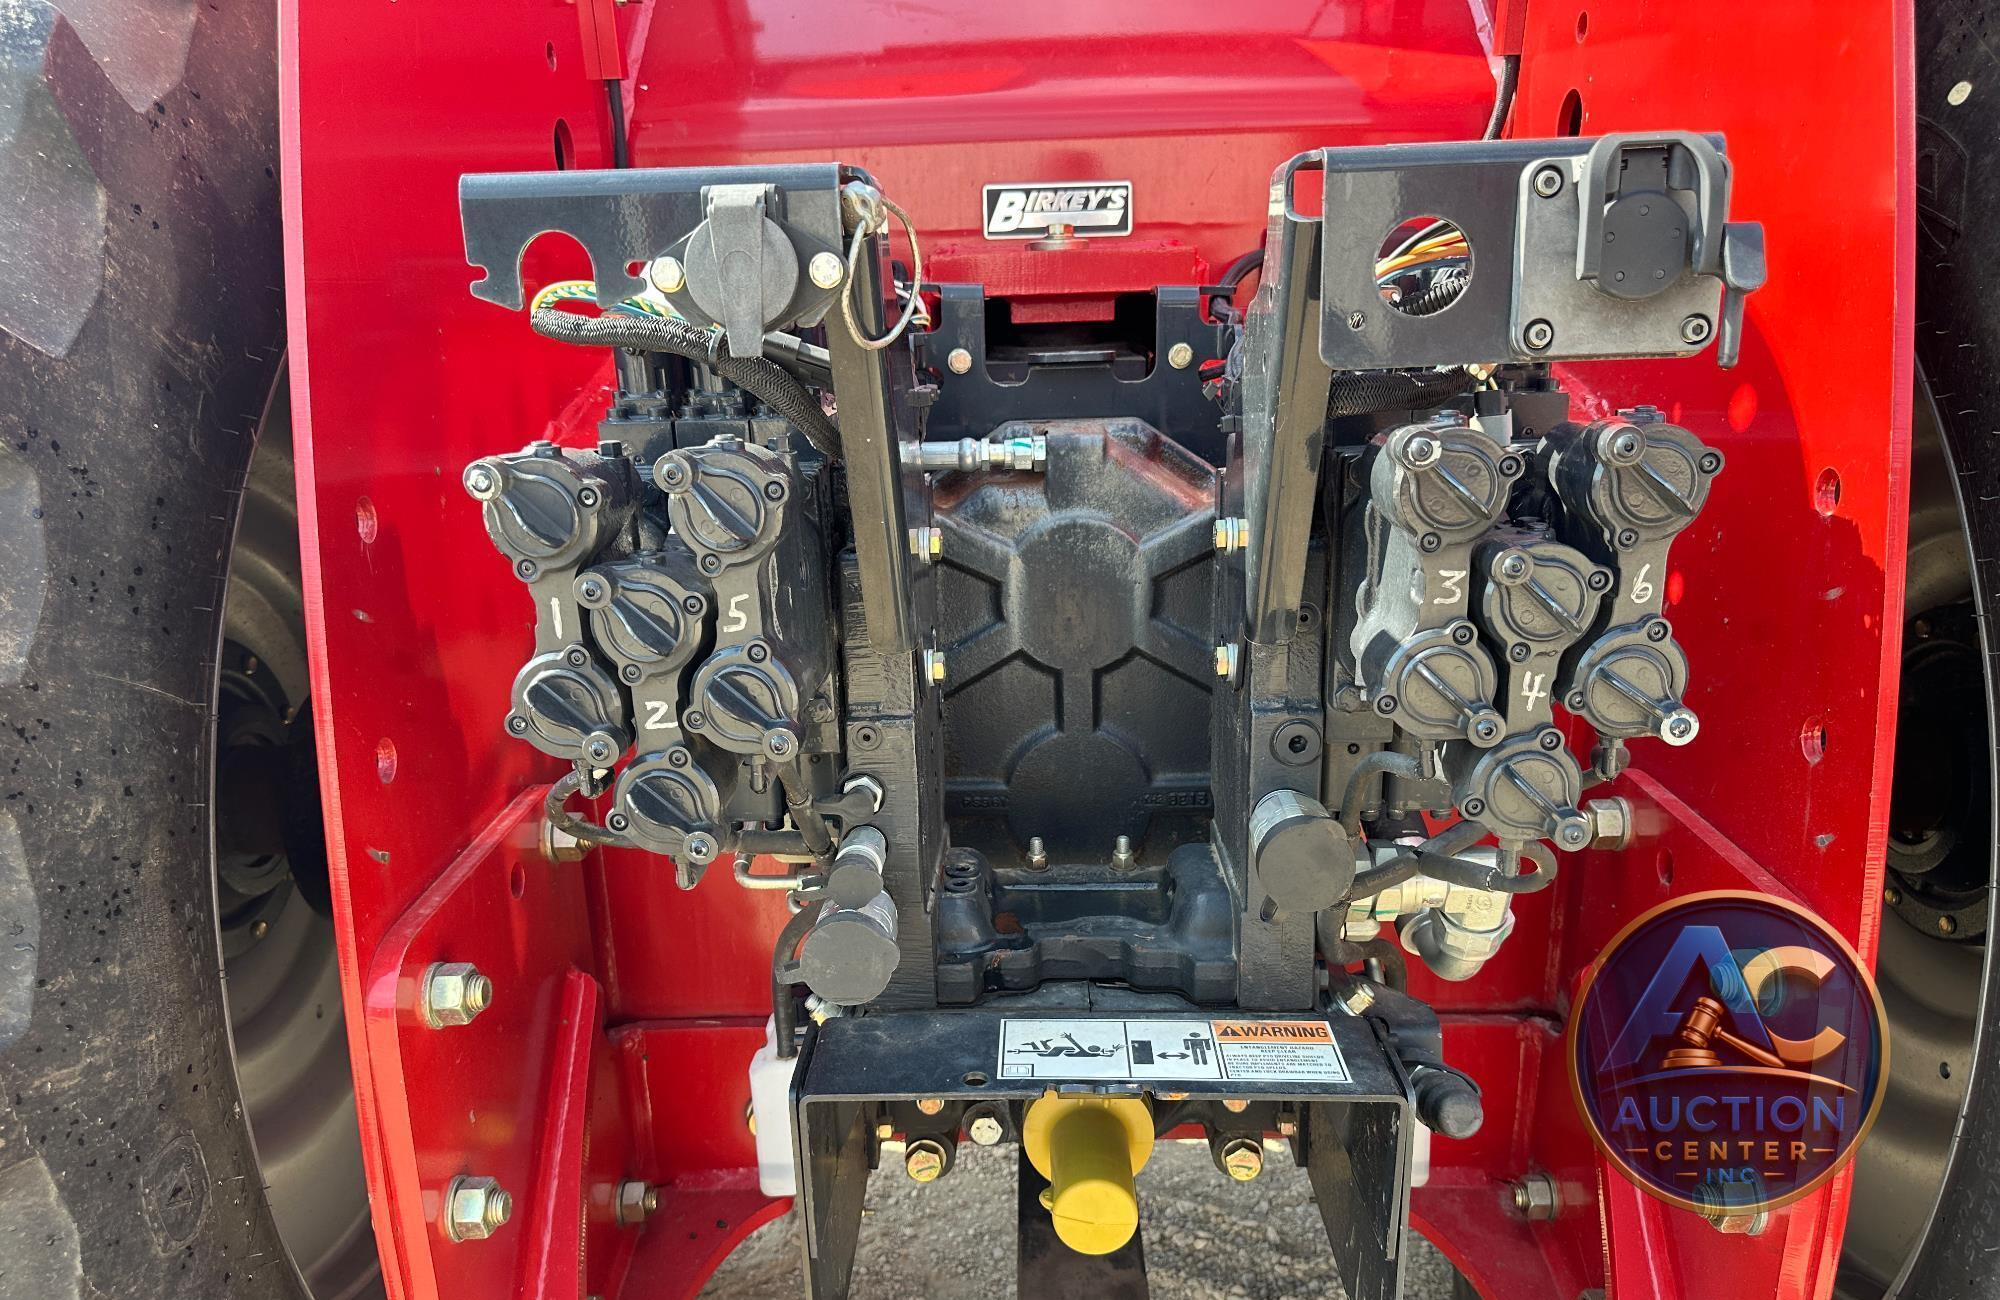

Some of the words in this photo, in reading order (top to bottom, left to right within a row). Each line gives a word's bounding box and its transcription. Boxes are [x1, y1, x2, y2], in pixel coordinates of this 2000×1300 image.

[988, 188, 1127, 232] BIRKEY'S
[1433, 569, 1466, 604] 3
[1630, 563, 1653, 603] 6
[550, 597, 563, 640] 1
[722, 594, 749, 633] 5
[1520, 671, 1546, 711] 4
[645, 701, 678, 730] 2
[1240, 1026, 1328, 1037] WARNING
